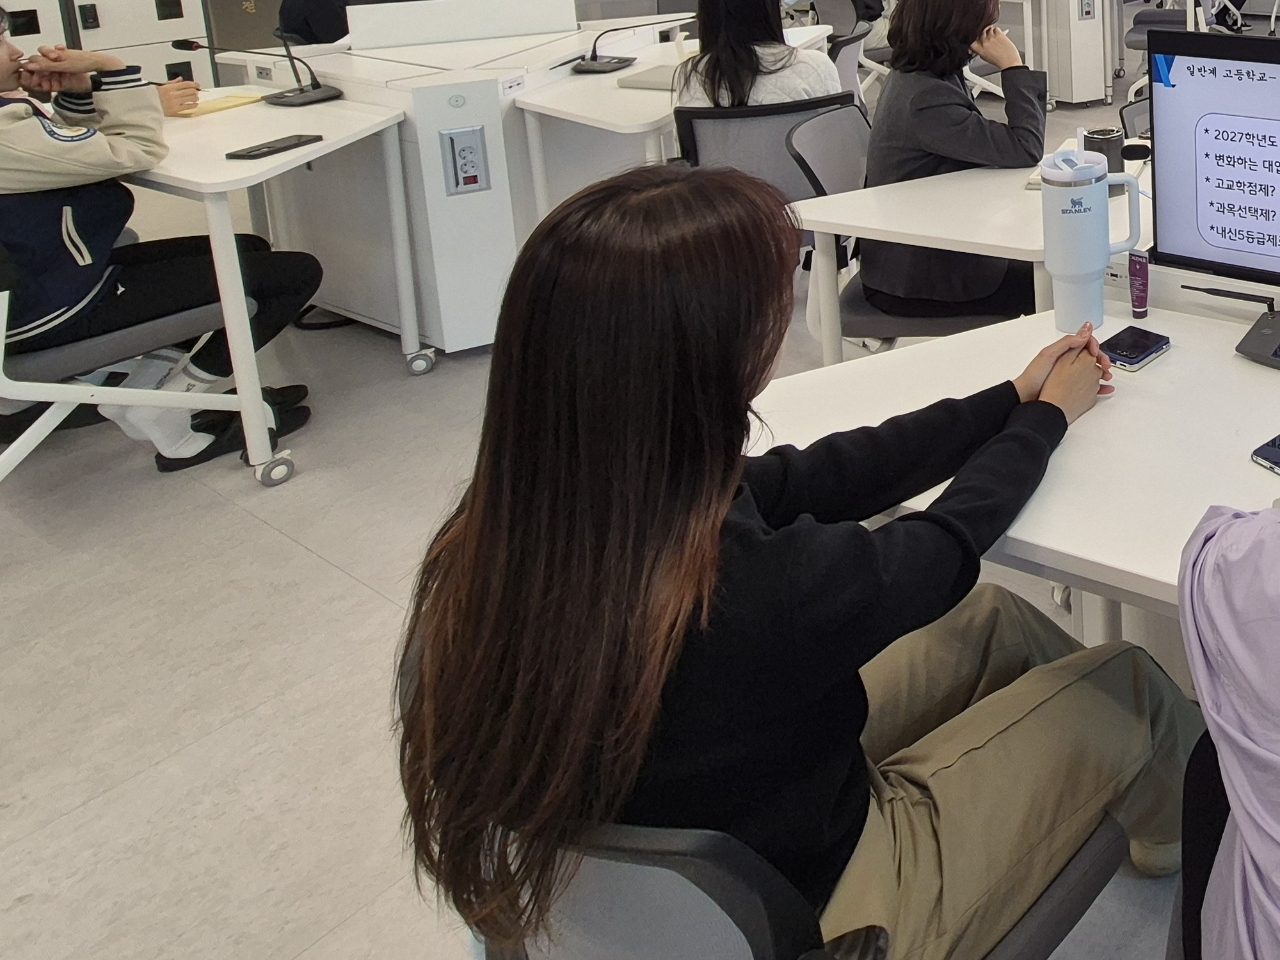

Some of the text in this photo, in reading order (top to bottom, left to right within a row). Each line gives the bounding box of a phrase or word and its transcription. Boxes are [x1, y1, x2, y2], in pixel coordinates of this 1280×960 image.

[1186, 64, 1217, 79] 일반계
[1214, 129, 1278, 148] 2027학년도
[1214, 153, 1259, 172] 변화하는
[1214, 177, 1276, 197] 고교학점제?
[1061, 206, 1092, 215] STANLEY
